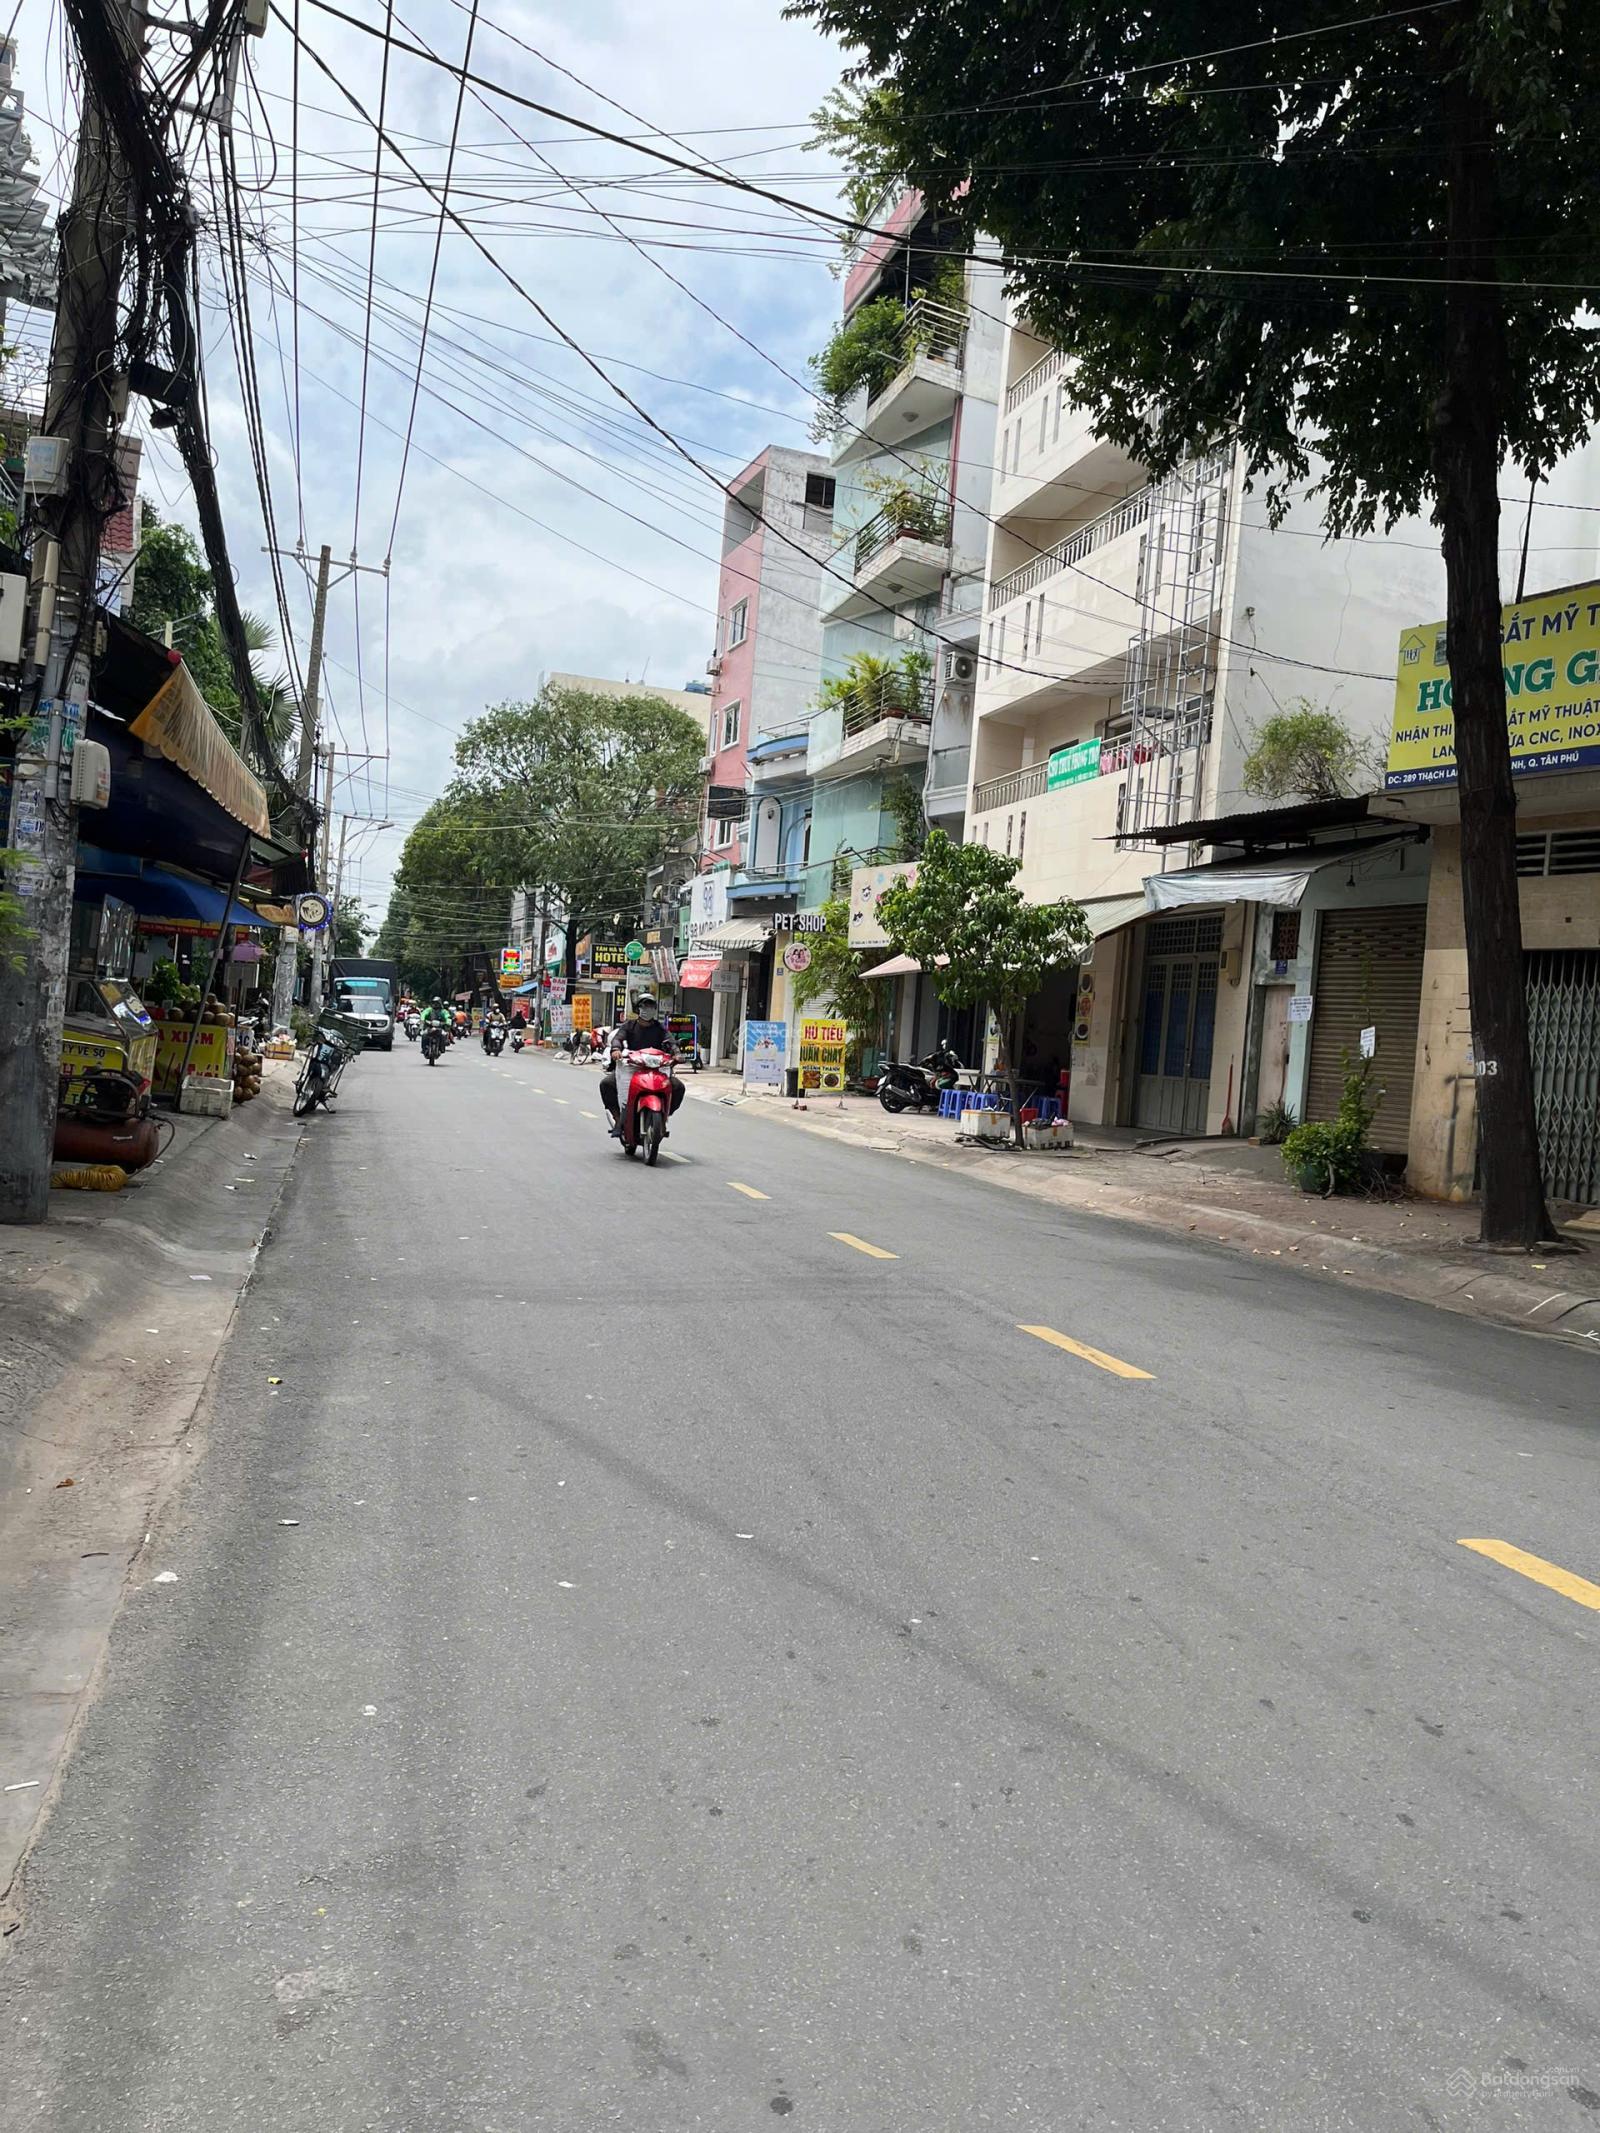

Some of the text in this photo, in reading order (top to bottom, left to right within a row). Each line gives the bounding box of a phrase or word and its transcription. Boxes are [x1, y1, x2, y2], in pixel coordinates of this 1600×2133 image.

[1542, 602, 1580, 636] MỸ
[1395, 725, 1430, 744] NHẬN
[1529, 704, 1551, 723] MỸ
[1555, 697, 1600, 719] THUẬT
[1529, 728, 1563, 746] CNC,
[1403, 773, 1417, 784] 289
[1540, 753, 1558, 766] TÂN
[774, 912, 827, 933] PET SHOP
[170, 1029, 215, 1046] XIM
